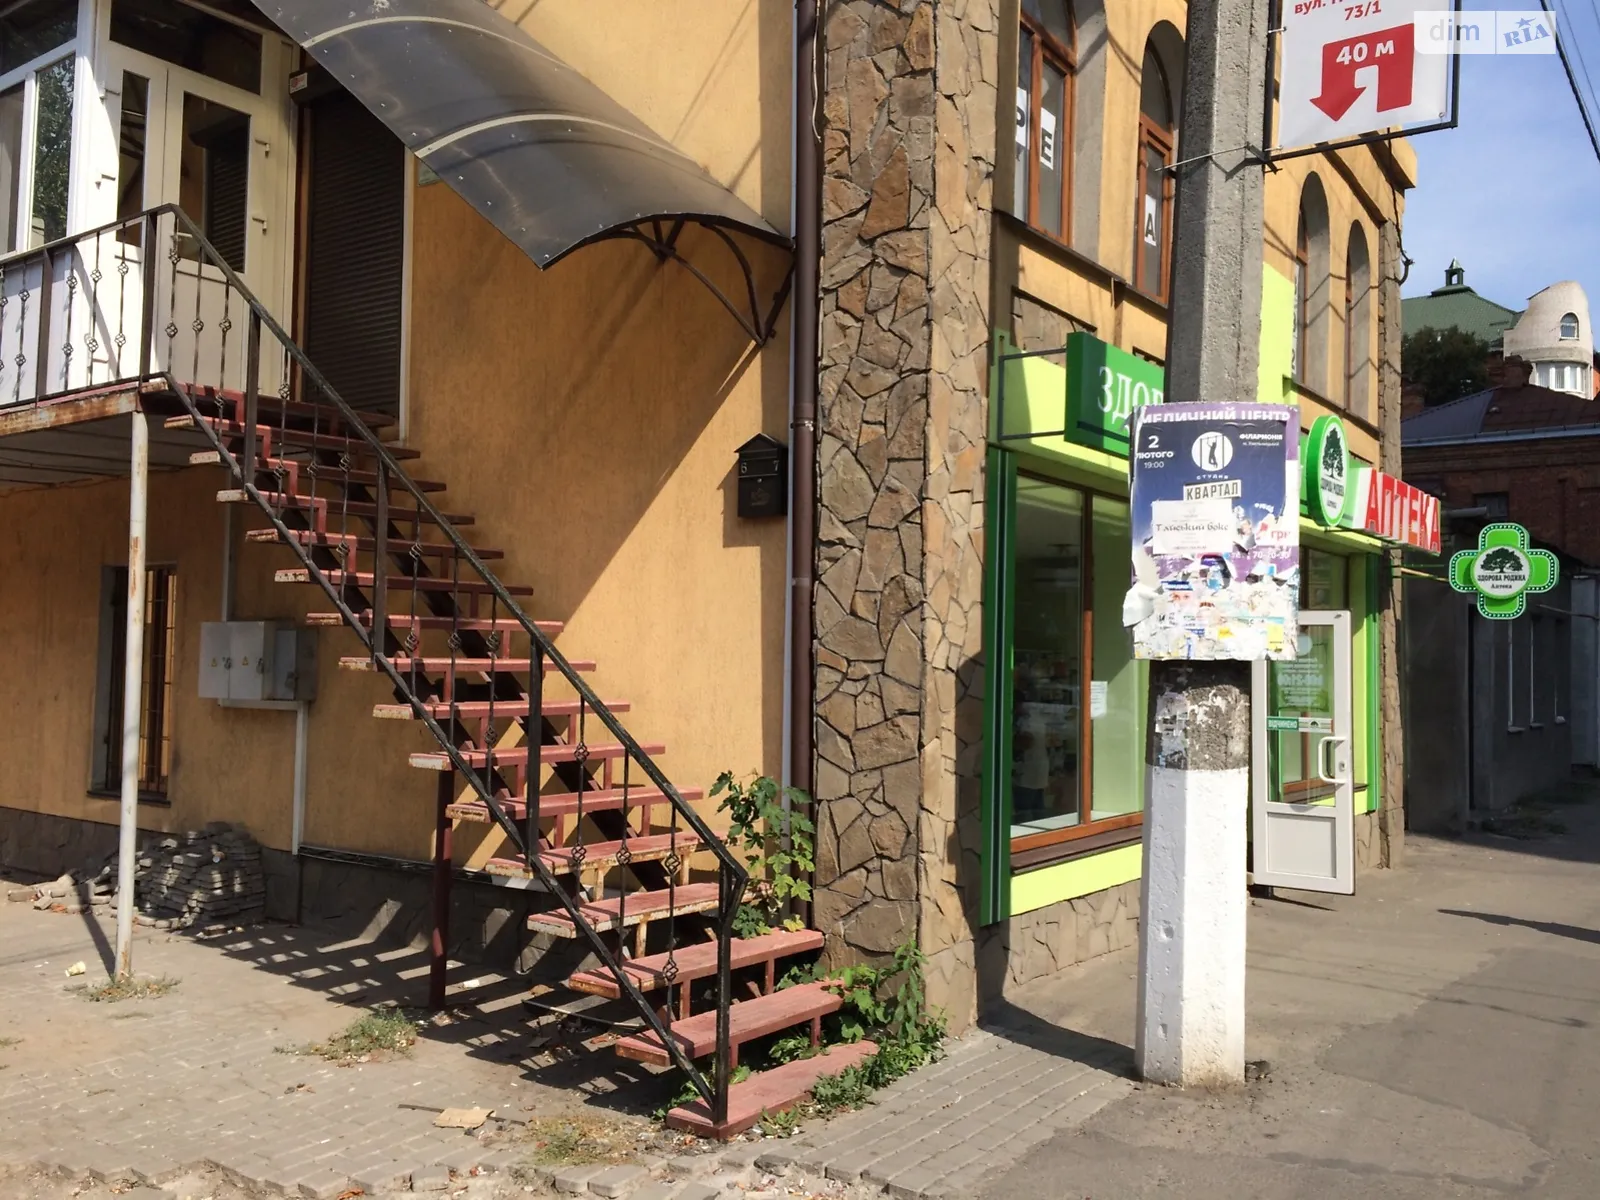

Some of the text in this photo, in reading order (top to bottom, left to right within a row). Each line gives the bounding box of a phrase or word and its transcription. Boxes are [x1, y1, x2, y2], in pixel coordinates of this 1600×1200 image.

[1344, 0, 1381, 21] 73/1
[1336, 39, 1395, 65] 40 м
[1148, 435, 1160, 449] 2
[1136, 451, 1174, 460] ЛЮТОГО
[741, 462, 748, 474] 6
[1144, 461, 1165, 469] 19:00
[1186, 482, 1240, 501] КВАРТАЛ
[1365, 468, 1441, 552] АПТЕКА
[1477, 574, 1503, 582] ЗДОРОВА
